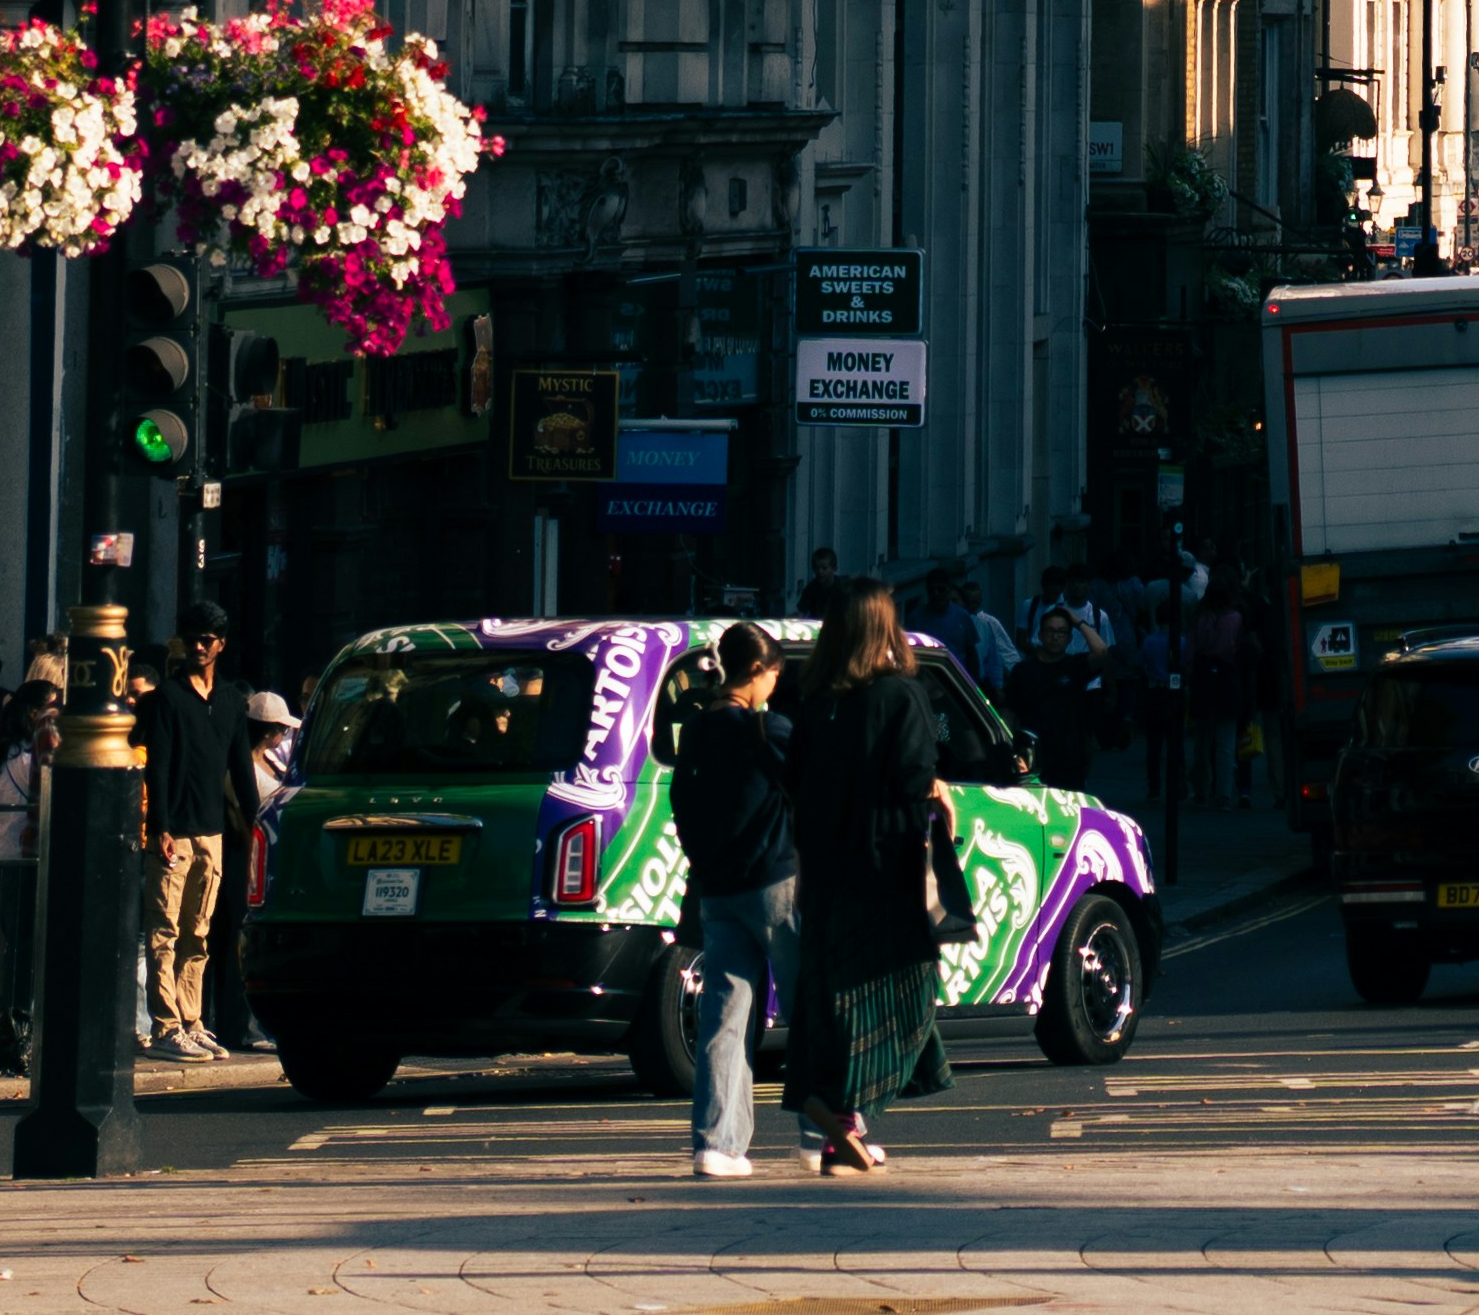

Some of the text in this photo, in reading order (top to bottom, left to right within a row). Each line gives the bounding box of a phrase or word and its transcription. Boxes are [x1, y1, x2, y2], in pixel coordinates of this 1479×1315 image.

[809, 265, 907, 279] AMERICAN
[821, 281, 894, 294] SWEETS
[850, 295, 865, 308] &
[822, 310, 893, 323] DRINKS
[1105, 342, 1184, 357] WALKERS
[827, 352, 894, 372] MONEY
[538, 376, 594, 393] MYSTIC
[809, 379, 910, 400] EXCHANGE
[810, 408, 908, 420] 0% COMMISSION
[525, 454, 602, 472] TREASURES
[626, 451, 701, 467] MONEY
[606, 500, 719, 517] EXCHANGE
[353, 839, 452, 862] LA23 XLE
[375, 886, 409, 898] 119320
